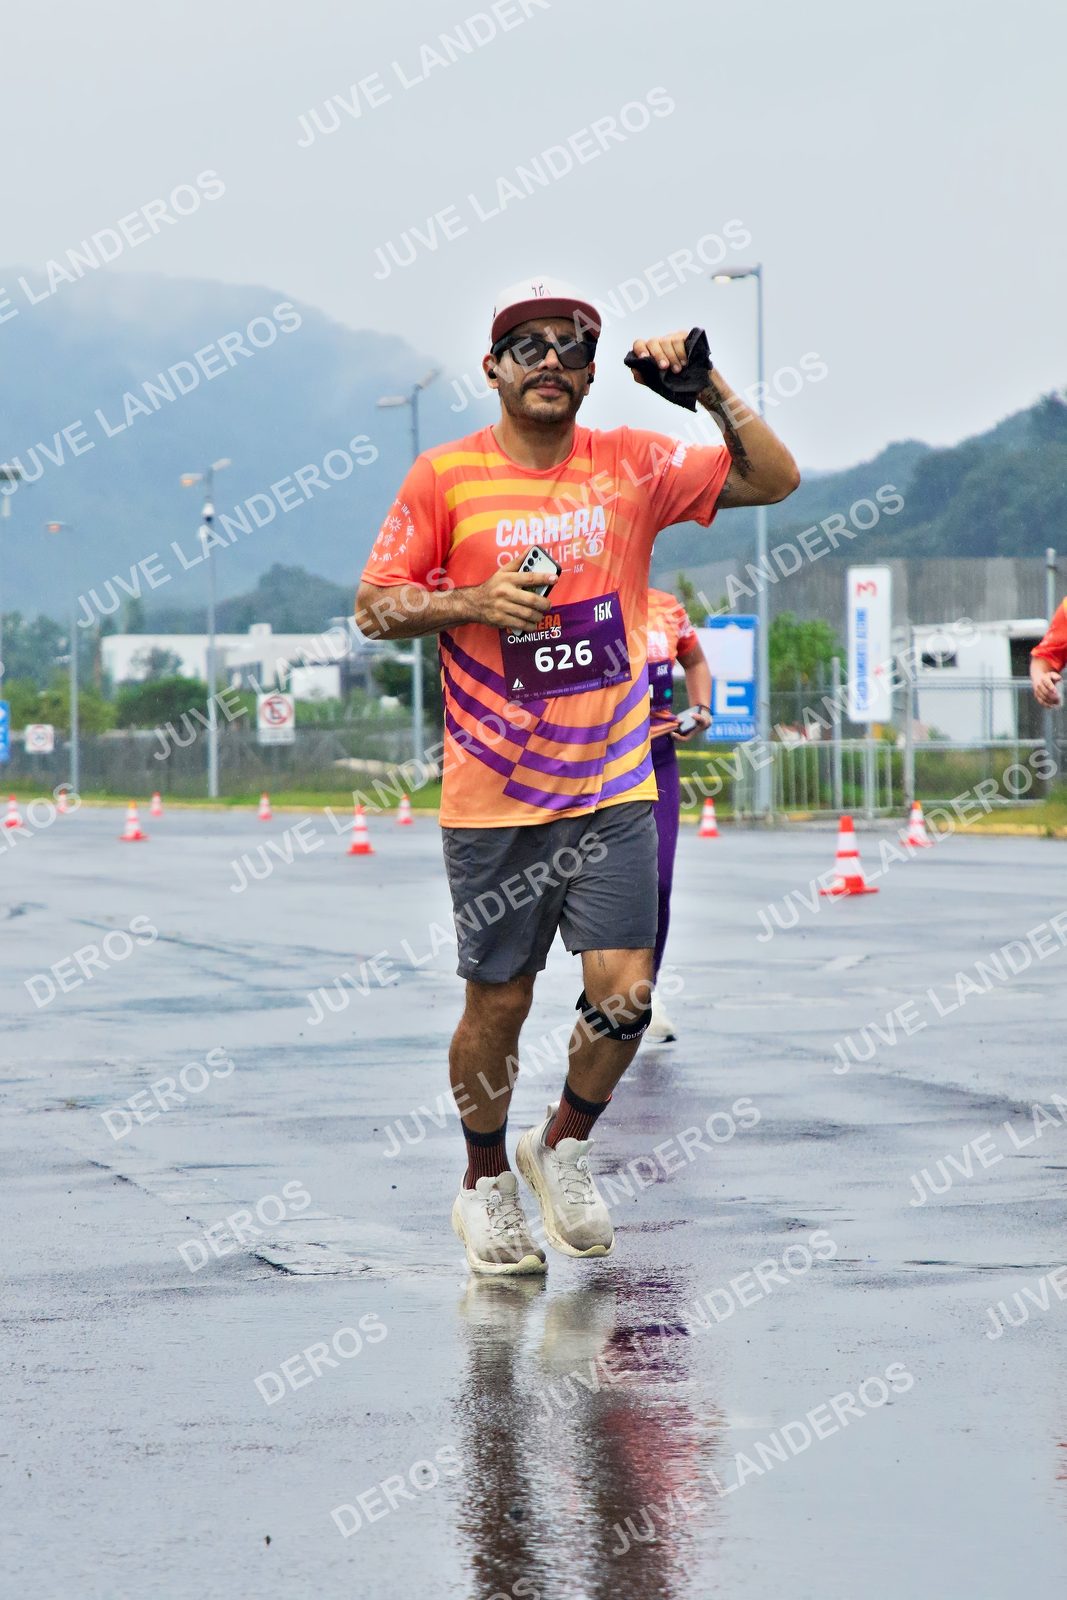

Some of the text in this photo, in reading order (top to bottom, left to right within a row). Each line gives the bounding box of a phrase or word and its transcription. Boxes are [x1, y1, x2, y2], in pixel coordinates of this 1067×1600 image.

[496, 505, 606, 547] CARRERA
[594, 601, 613, 622] 15K
[534, 640, 593, 673] 626
